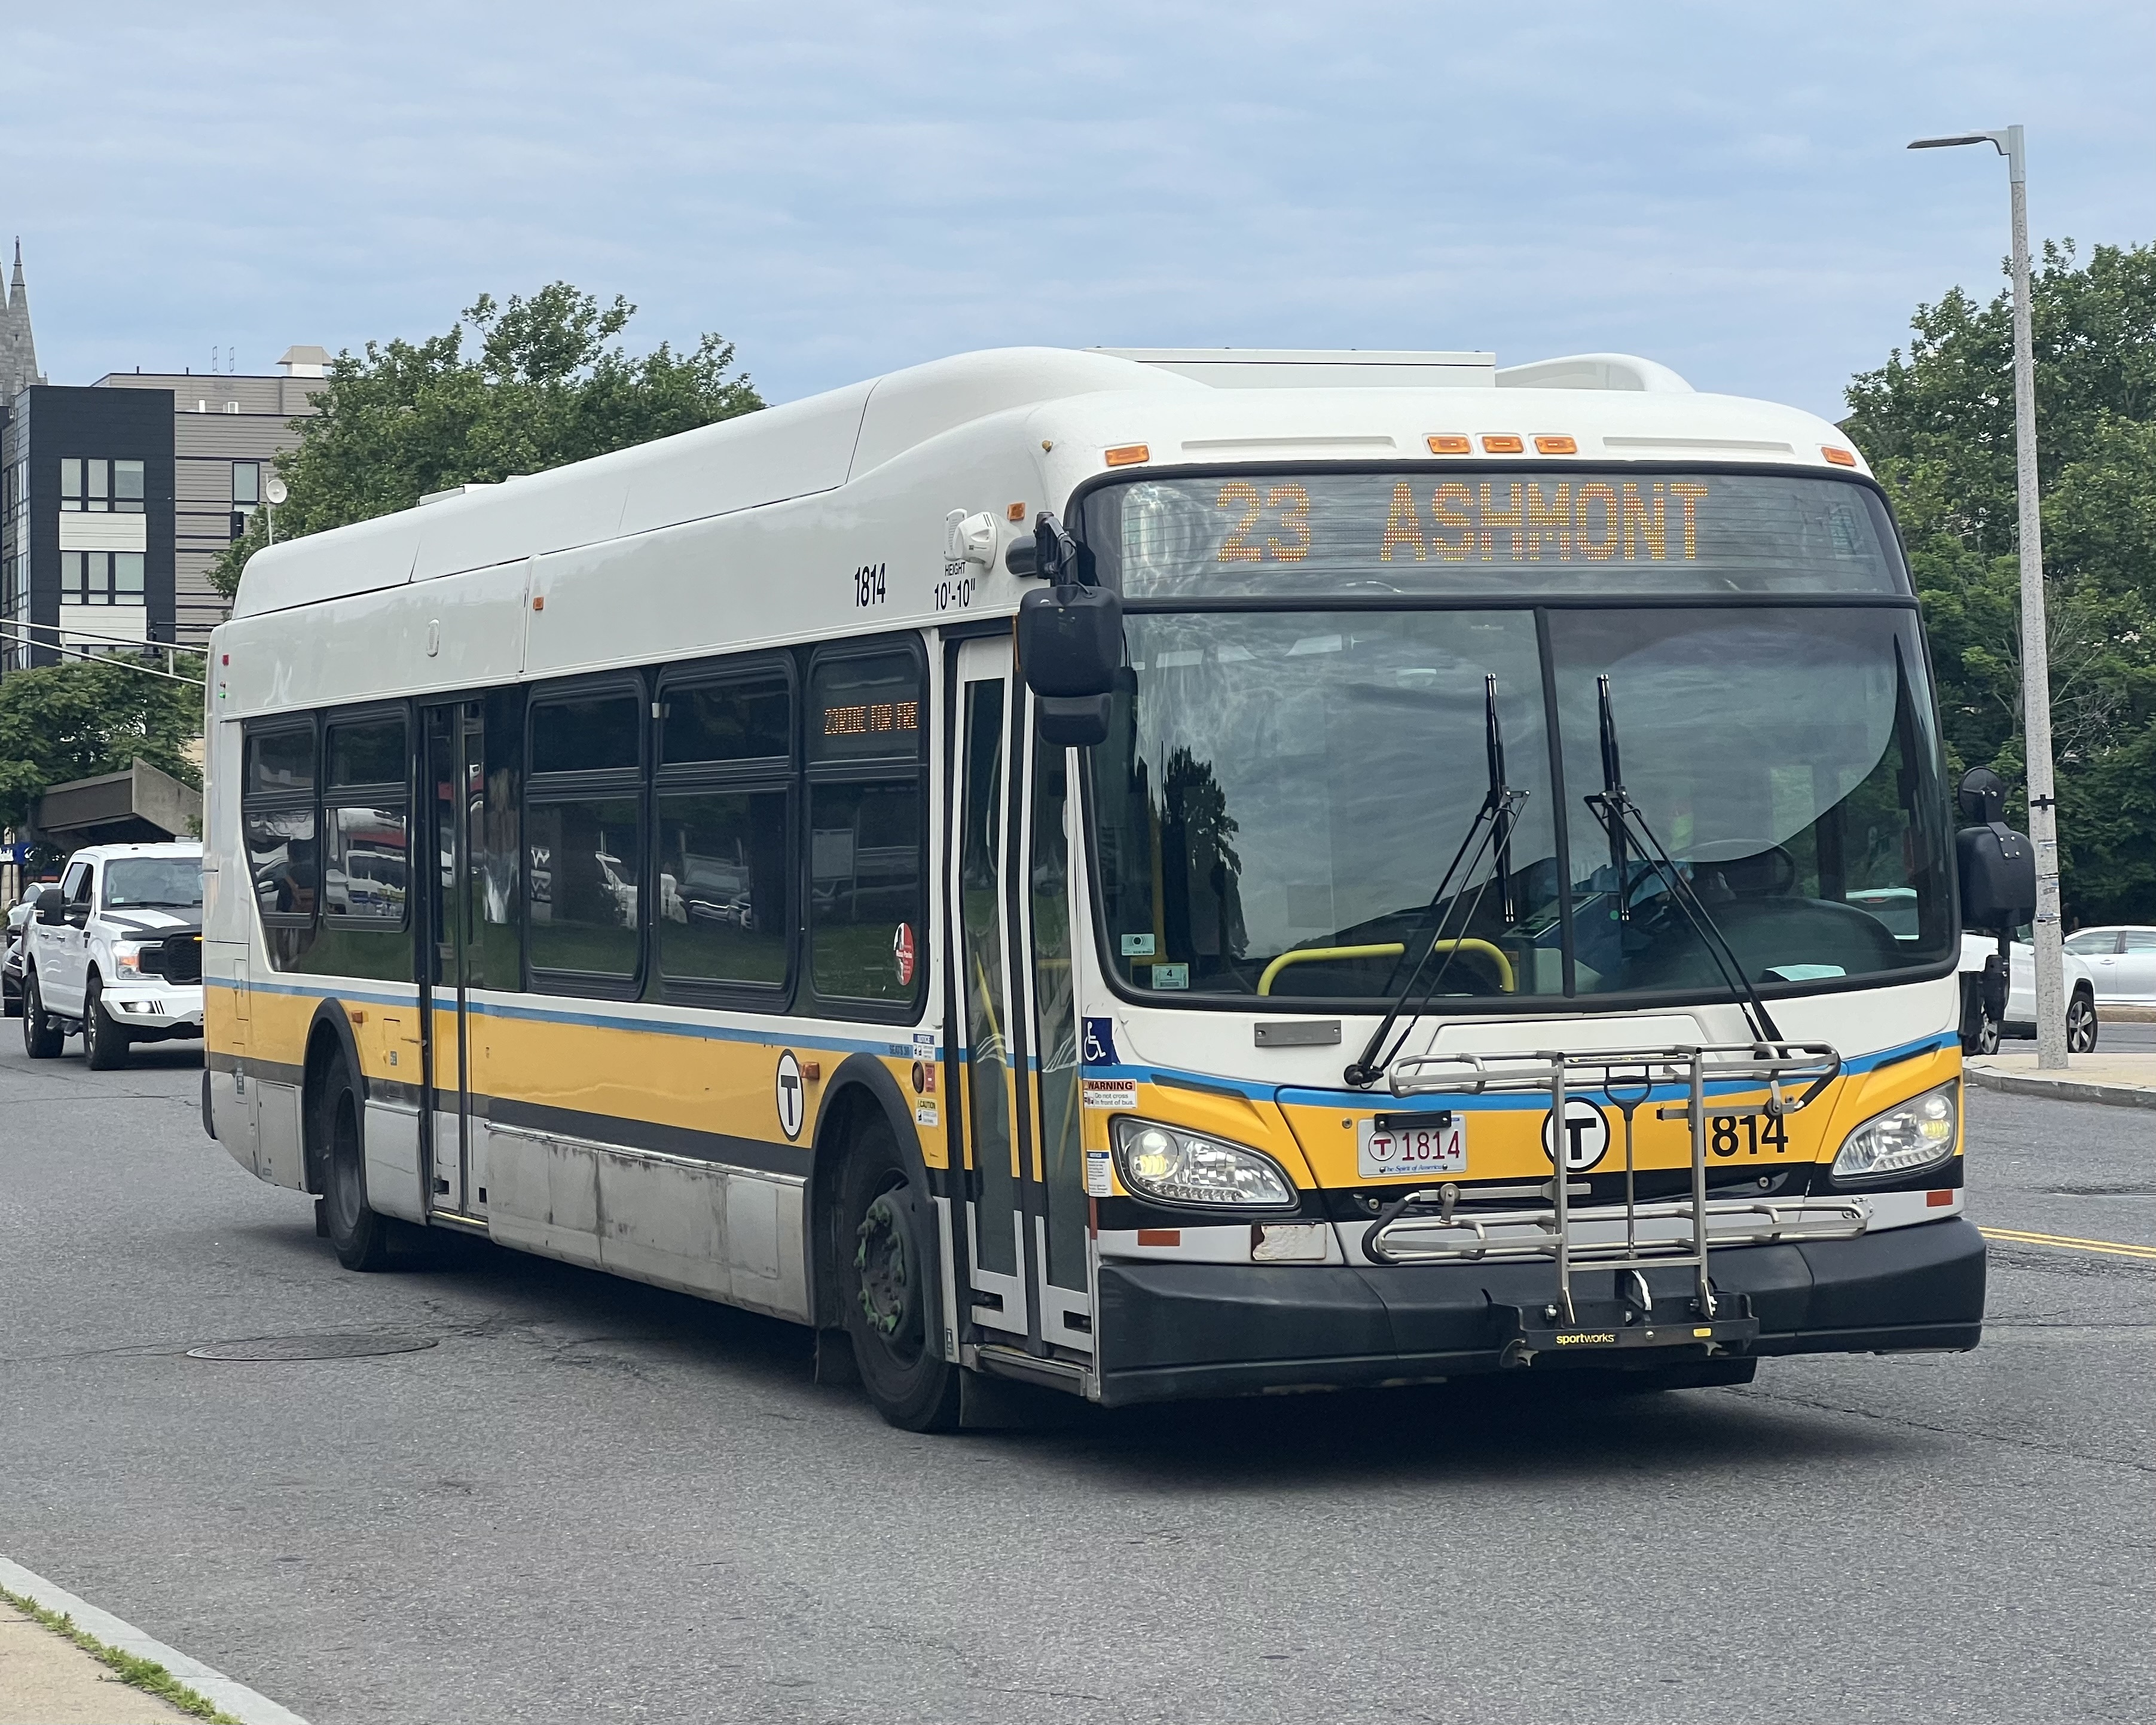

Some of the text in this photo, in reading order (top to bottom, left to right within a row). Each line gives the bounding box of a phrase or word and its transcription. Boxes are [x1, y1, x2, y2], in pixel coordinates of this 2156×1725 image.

[1216, 481, 1709, 561] 23 ASHMONT
[945, 561, 966, 576] HEIGHT
[854, 563, 885, 607] 1814
[935, 578, 975, 610] 10'-10"
[1166, 969, 1172, 978] 4
[781, 1074, 798, 1126] T
[1088, 1082, 1132, 1090] WARNING
[1373, 1130, 1460, 1161] T 1814
[1565, 1118, 1597, 1160] T
[1704, 1115, 1788, 1158] 814
[1556, 1333, 1615, 1345] sportworks
